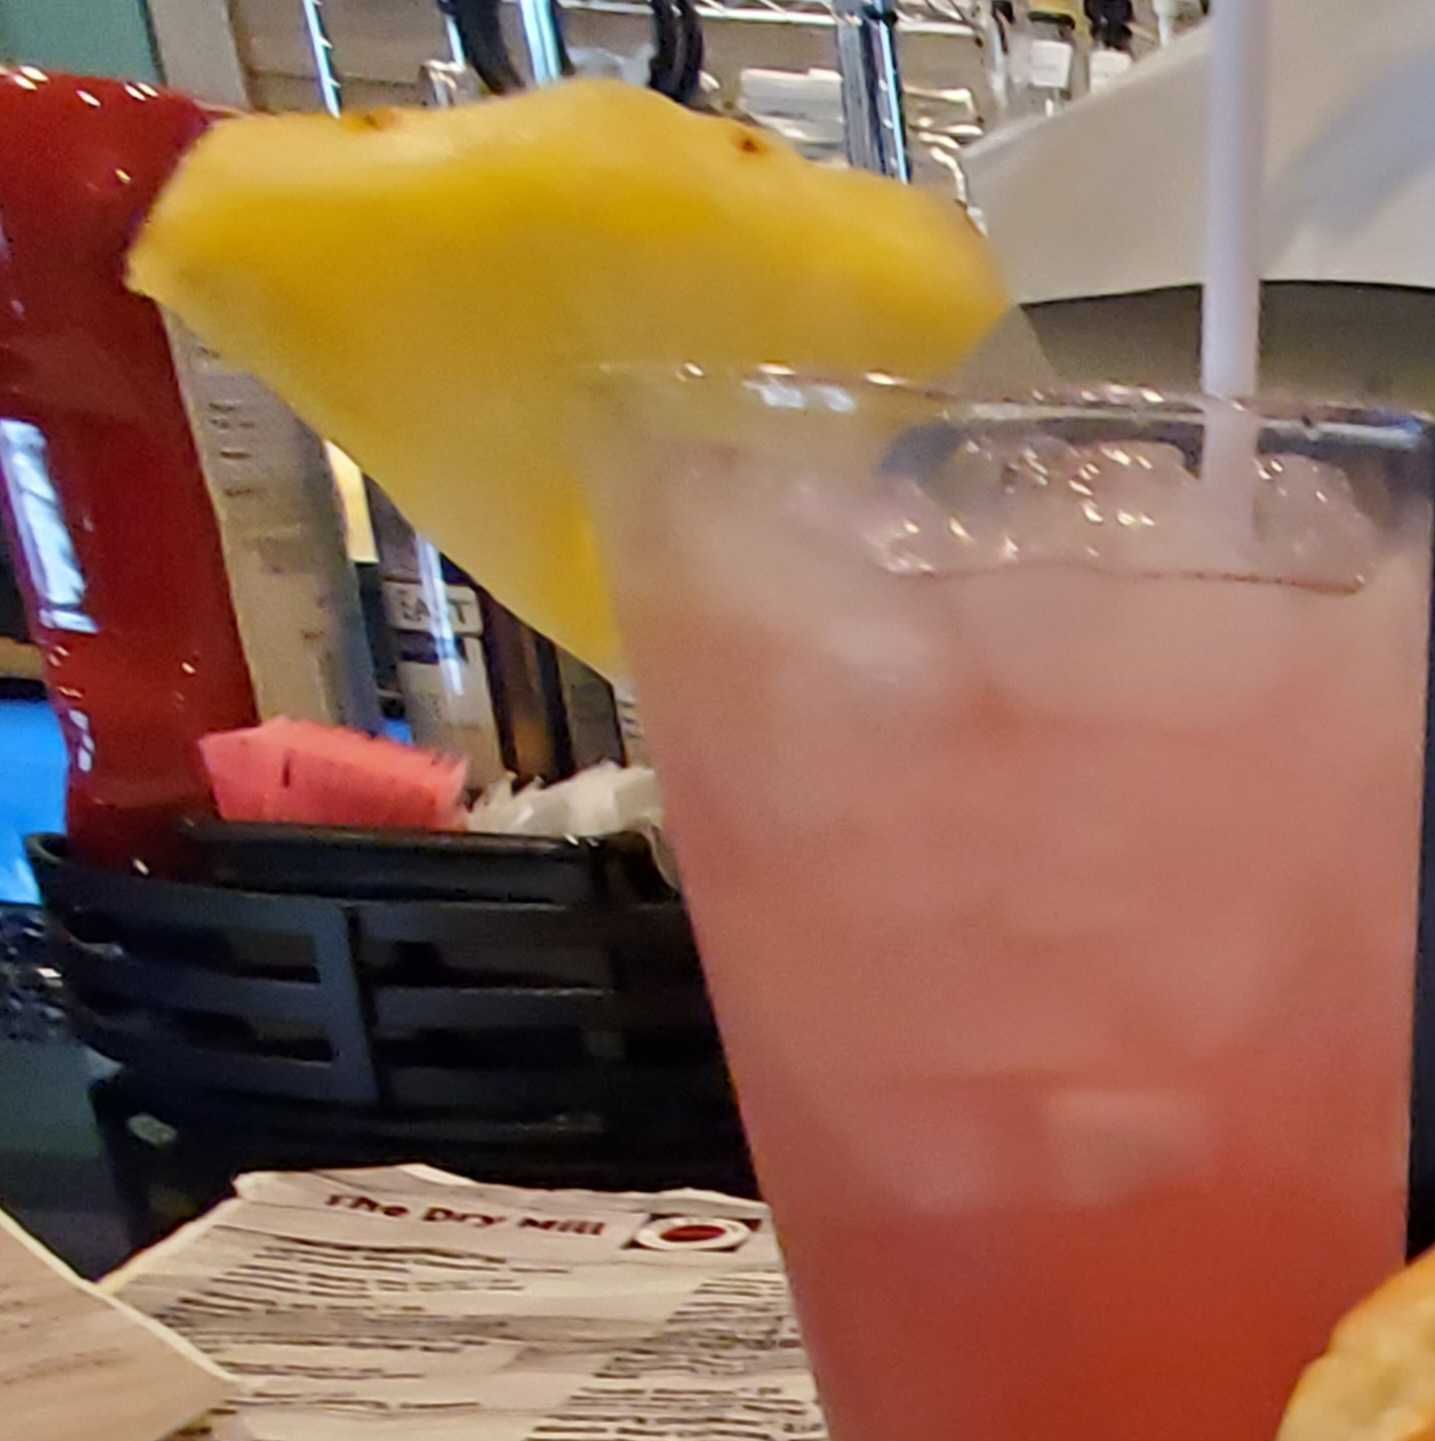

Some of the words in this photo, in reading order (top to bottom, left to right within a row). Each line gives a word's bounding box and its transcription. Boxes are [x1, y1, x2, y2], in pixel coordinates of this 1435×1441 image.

[324, 1193, 410, 1218] The
[421, 1206, 506, 1229] Dry
[517, 1216, 606, 1236] Mill
